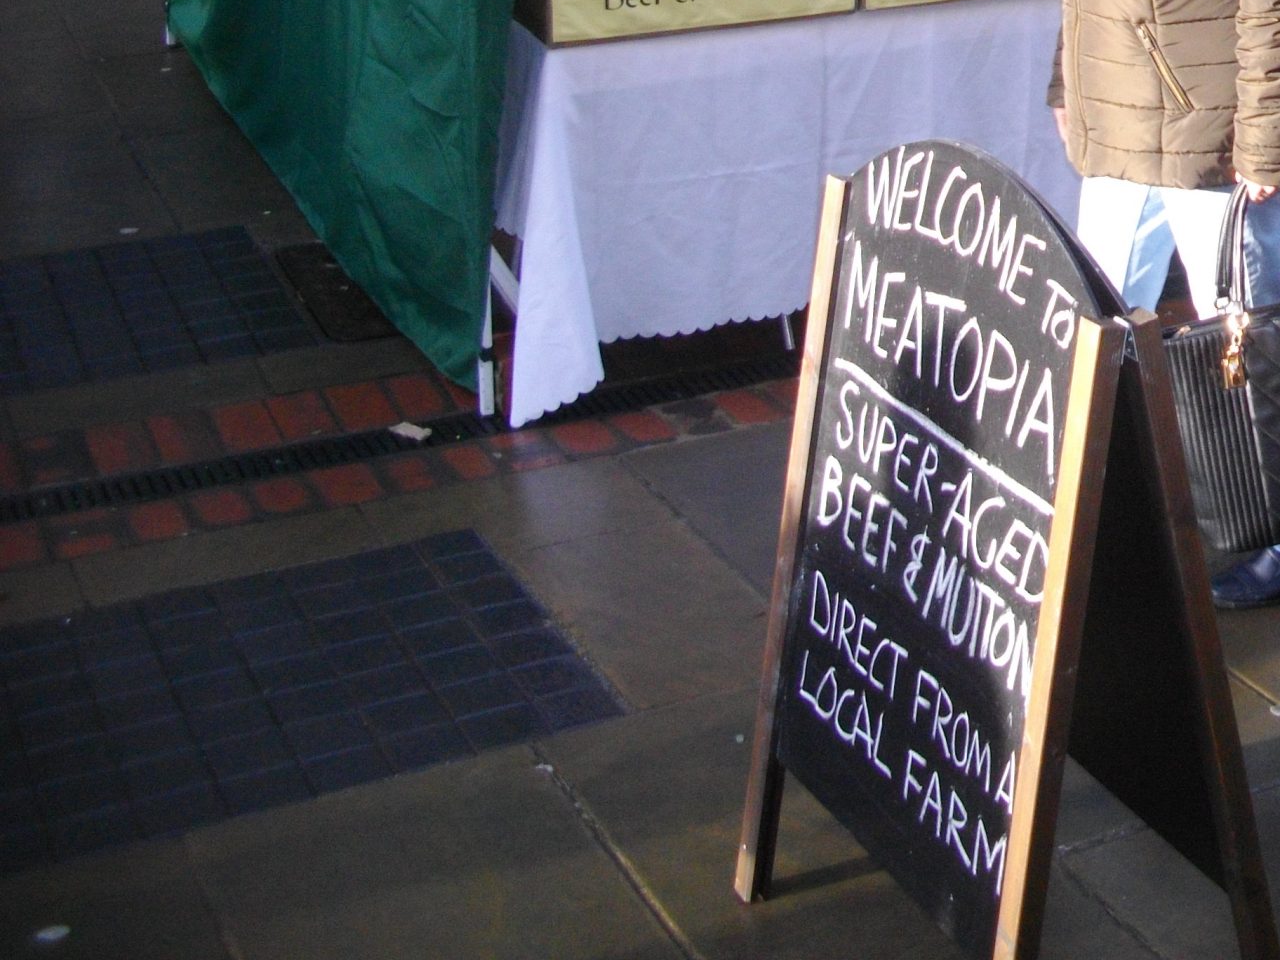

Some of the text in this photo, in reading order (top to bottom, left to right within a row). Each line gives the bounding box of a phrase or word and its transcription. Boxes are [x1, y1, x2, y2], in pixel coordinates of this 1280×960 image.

[866, 145, 1047, 306] WELCOME
[843, 232, 1056, 486] MEATOPIA
[816, 453, 1034, 708] BEEF & MUTTON
[835, 379, 1050, 603] SUPER-AGED
[799, 649, 1008, 896] LOCAL FARM
[807, 569, 1017, 815] DIRECT FROM A
